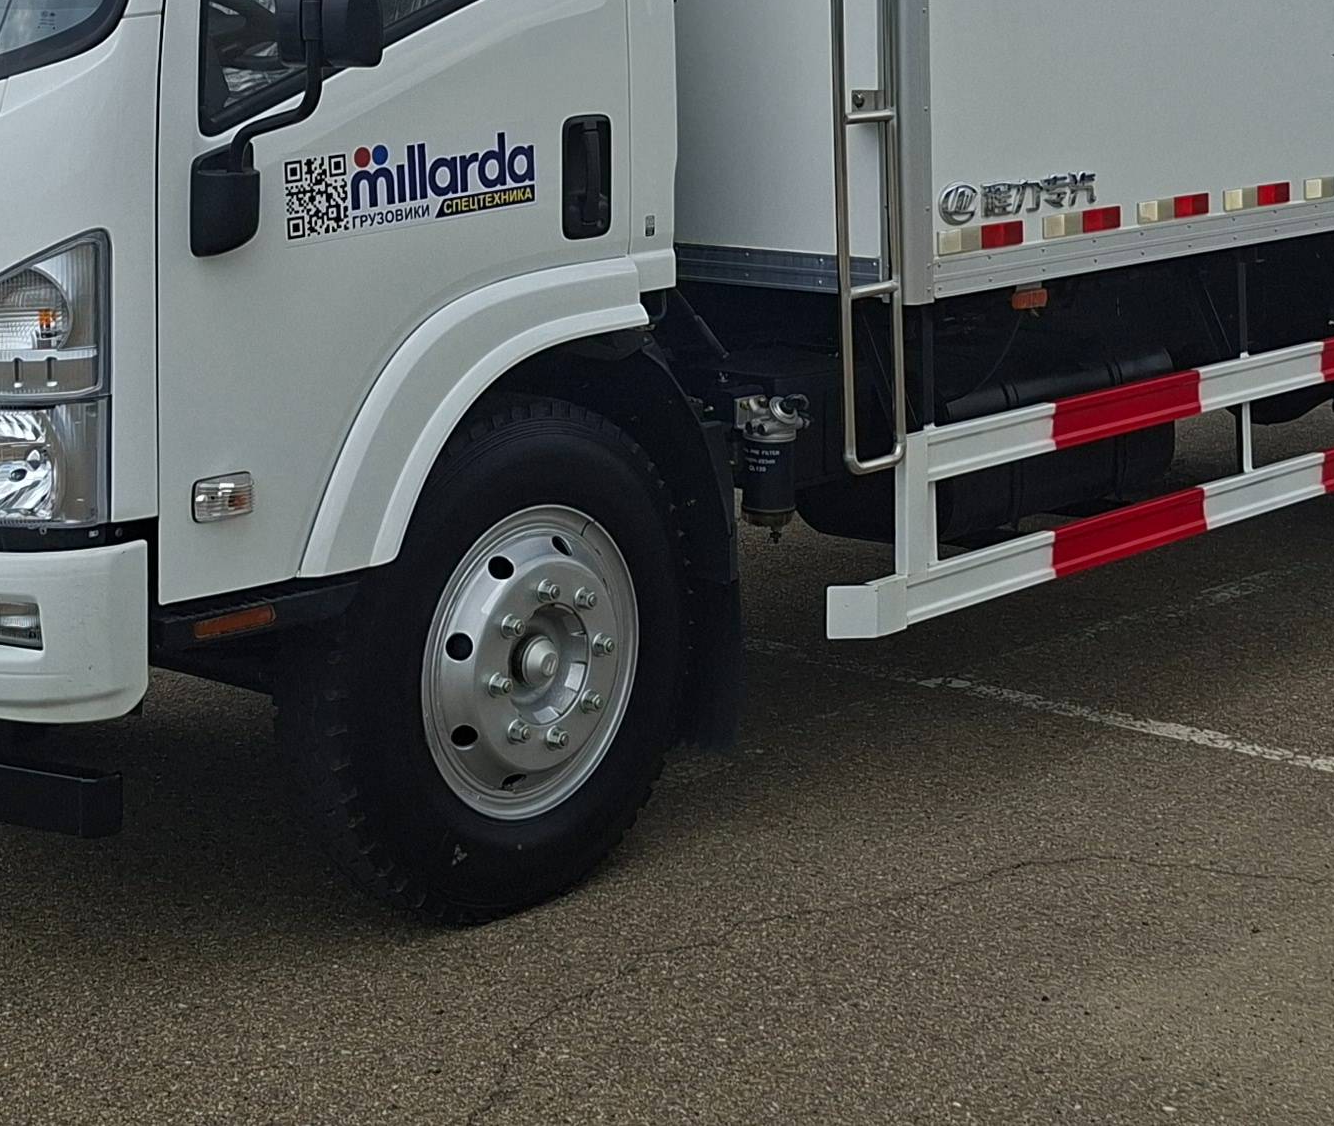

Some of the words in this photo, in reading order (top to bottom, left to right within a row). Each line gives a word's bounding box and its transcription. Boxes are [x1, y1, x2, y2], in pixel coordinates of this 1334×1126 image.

[351, 132, 535, 211] millarda
[352, 204, 430, 229] ГРУЗОВИКИ
[443, 187, 533, 214] СПЕЦТЕХНИКА
